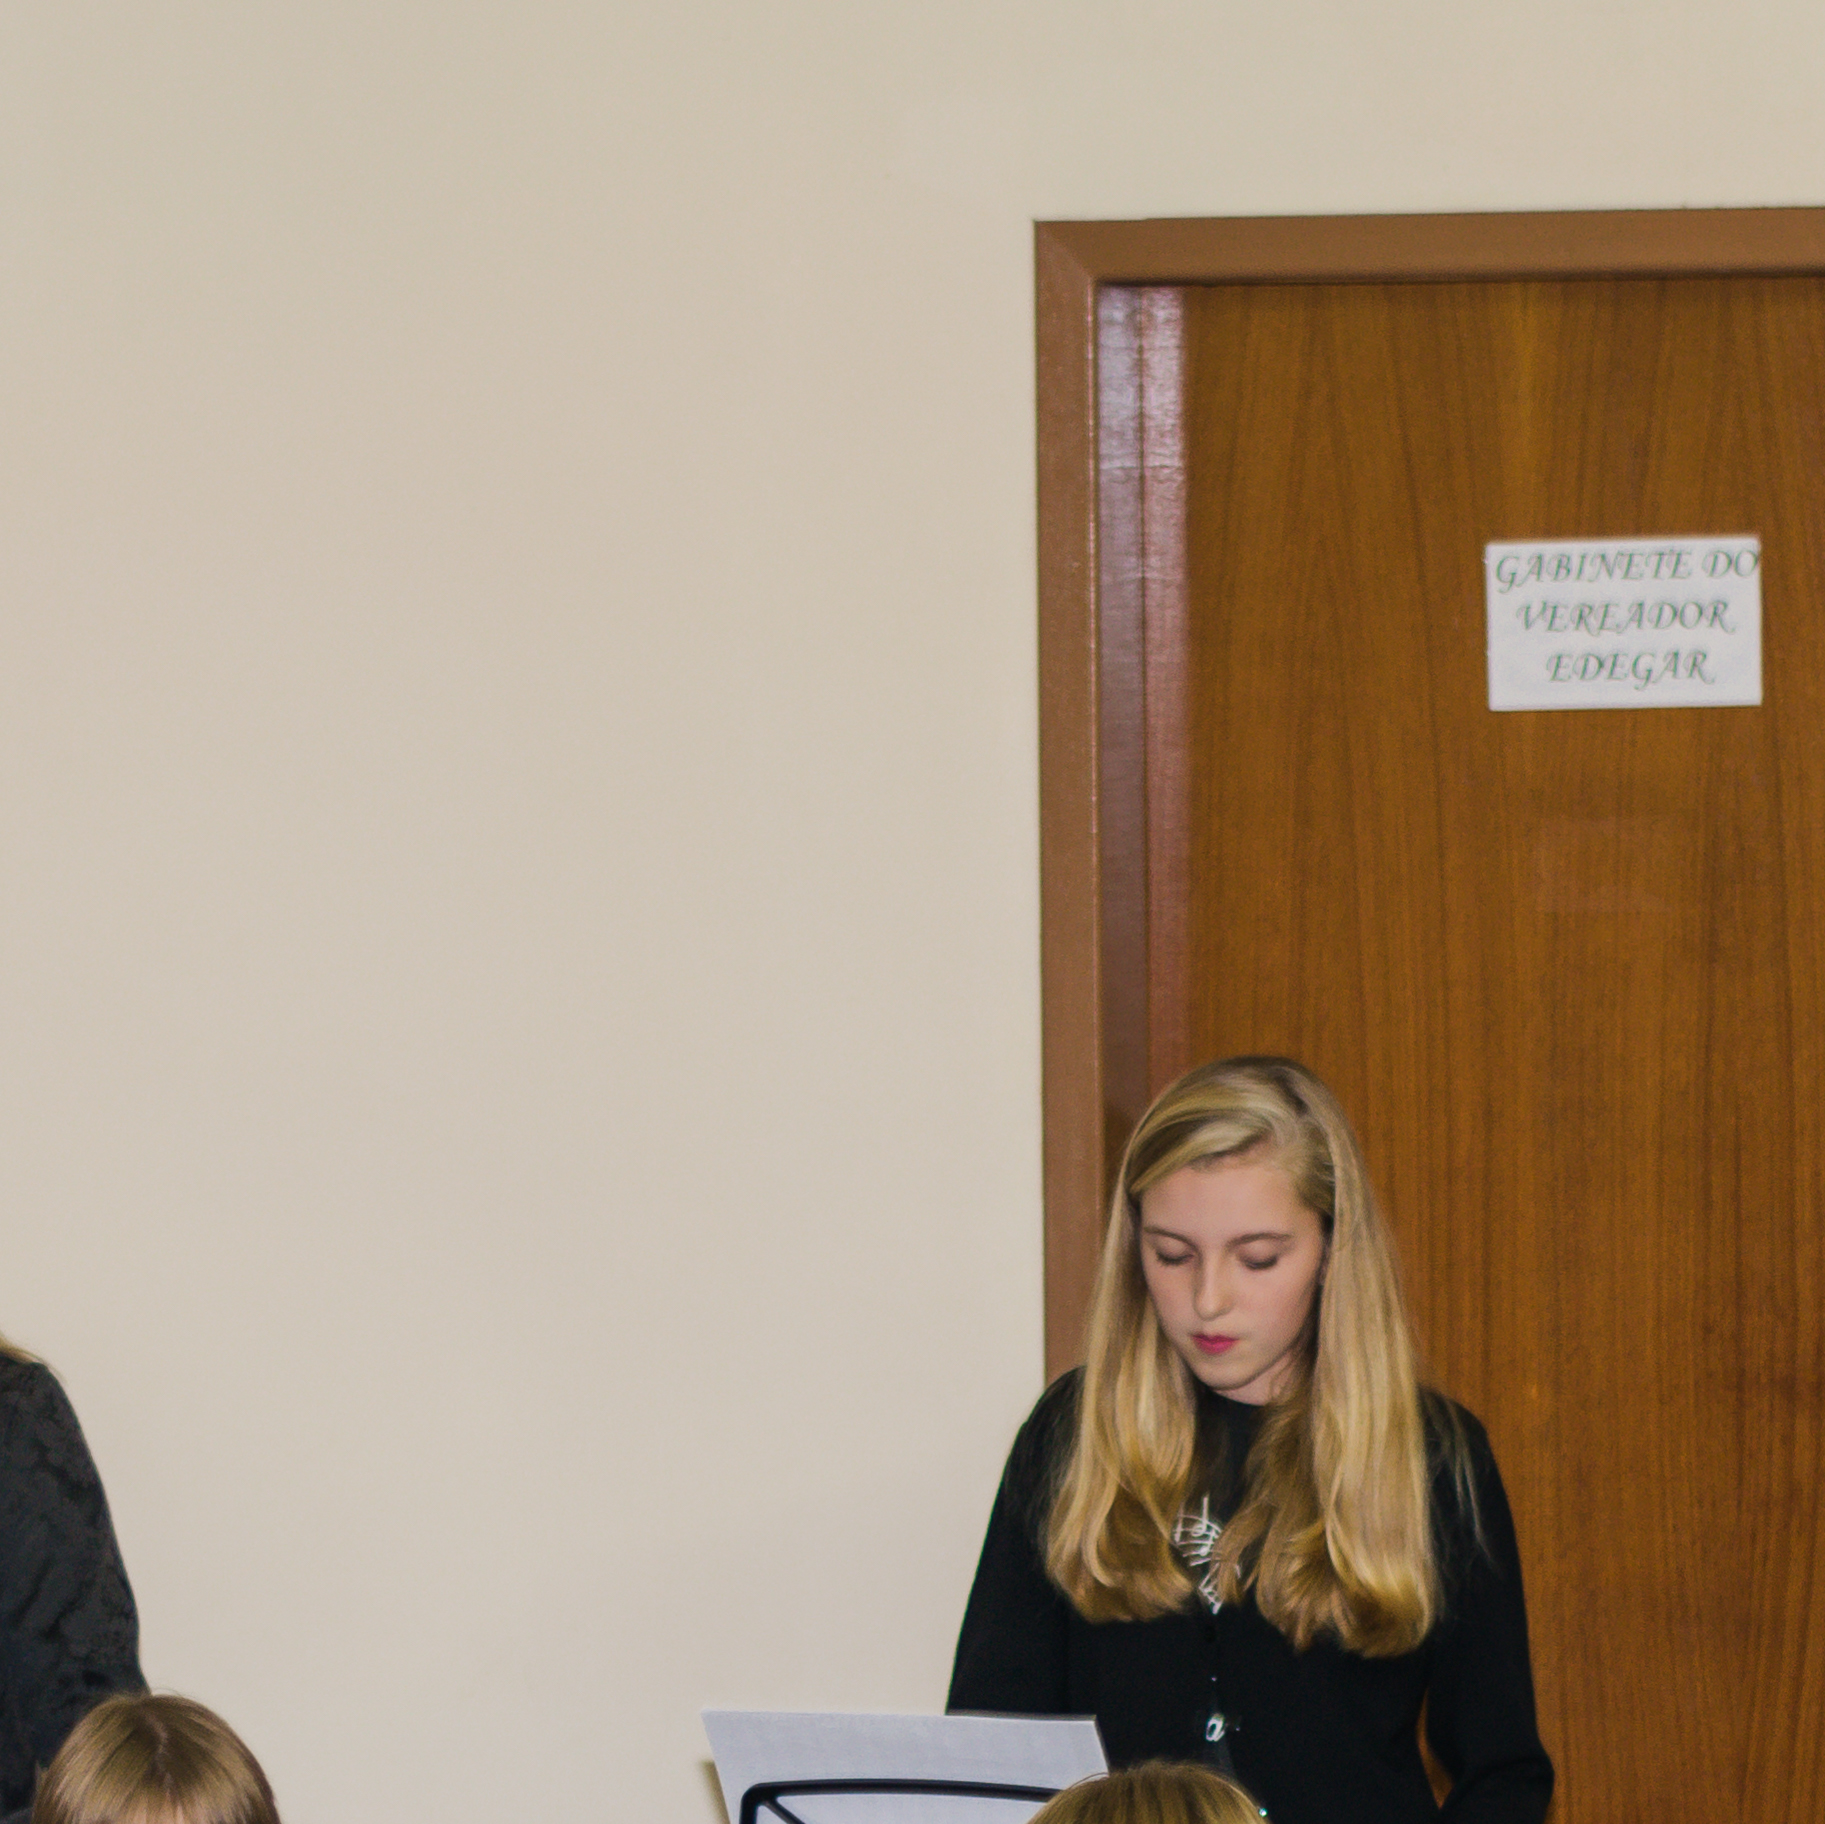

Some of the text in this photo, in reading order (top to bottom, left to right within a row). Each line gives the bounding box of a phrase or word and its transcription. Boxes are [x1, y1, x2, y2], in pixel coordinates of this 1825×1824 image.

[1496, 549, 1758, 594] GABINETE DO
[1516, 599, 1736, 637] VEREADOR
[1546, 650, 1715, 691] EDEGAR
